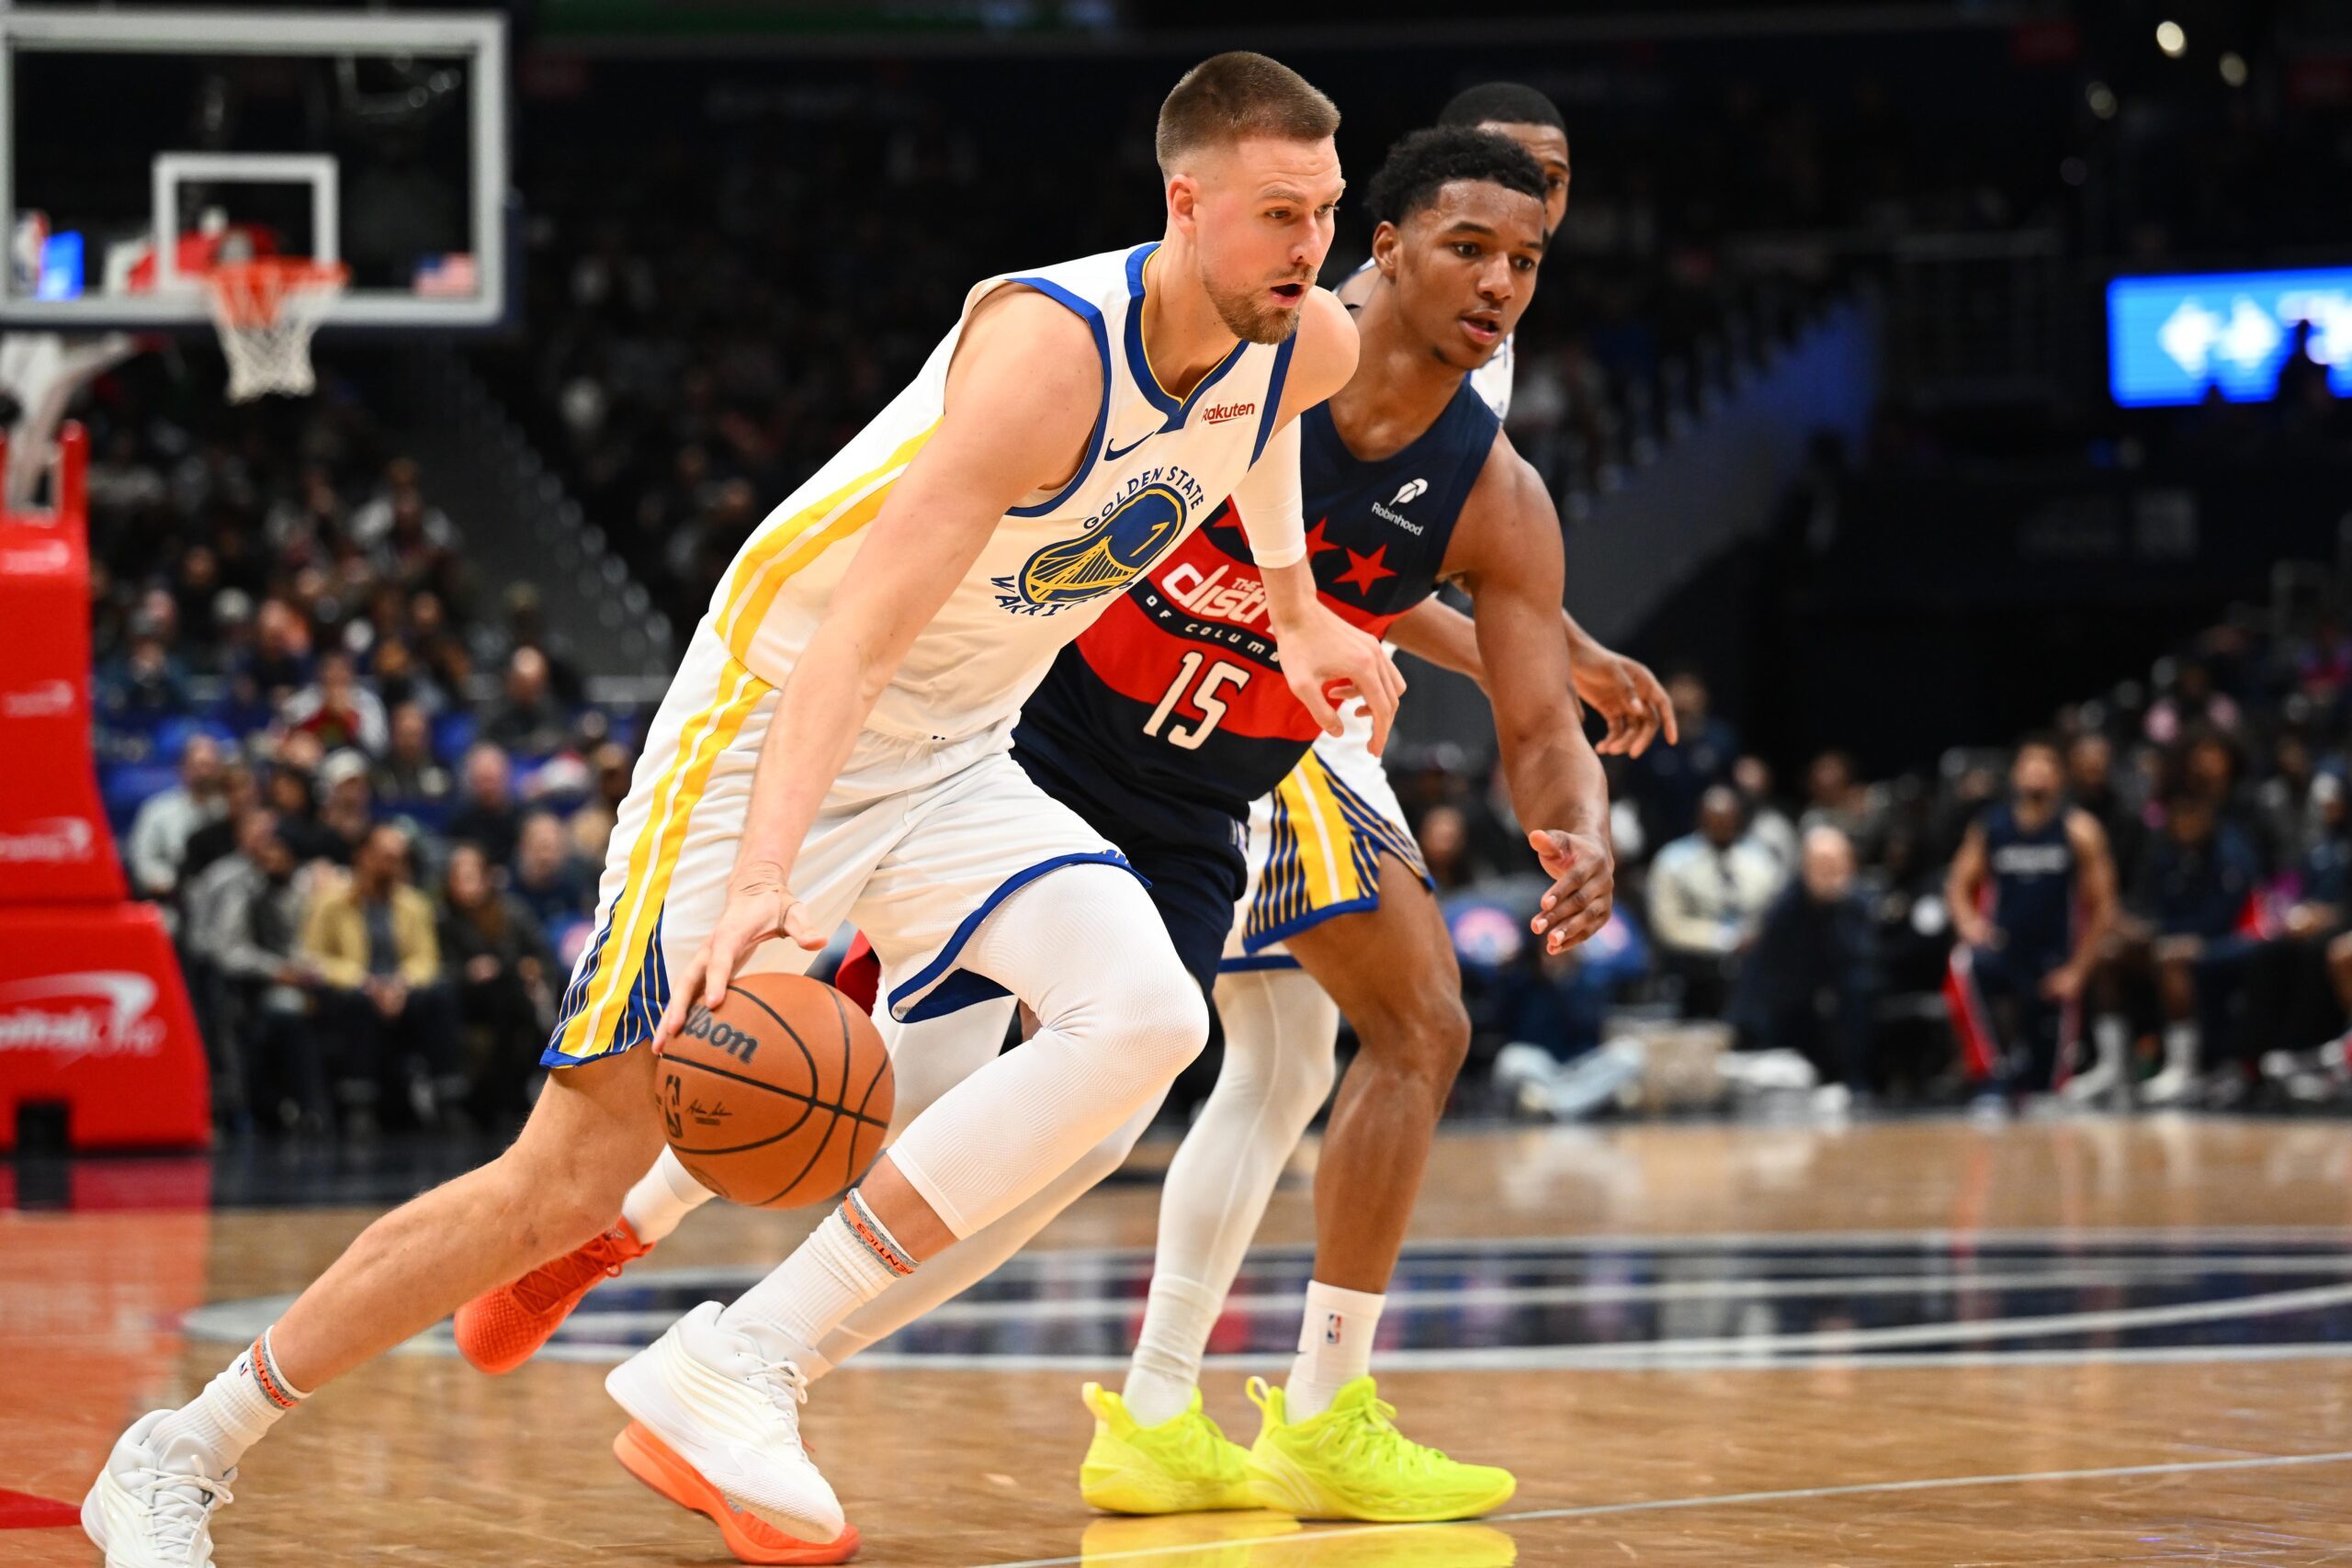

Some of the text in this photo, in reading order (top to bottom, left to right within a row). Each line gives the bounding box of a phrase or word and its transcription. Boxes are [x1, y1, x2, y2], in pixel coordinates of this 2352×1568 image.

[1201, 403, 1255, 423] Rakuten
[1084, 466, 1204, 530] GOLDEN STATE
[1371, 502, 1424, 536] Robinhood
[1231, 577, 1261, 592] THE
[1142, 650, 1250, 750] 15
